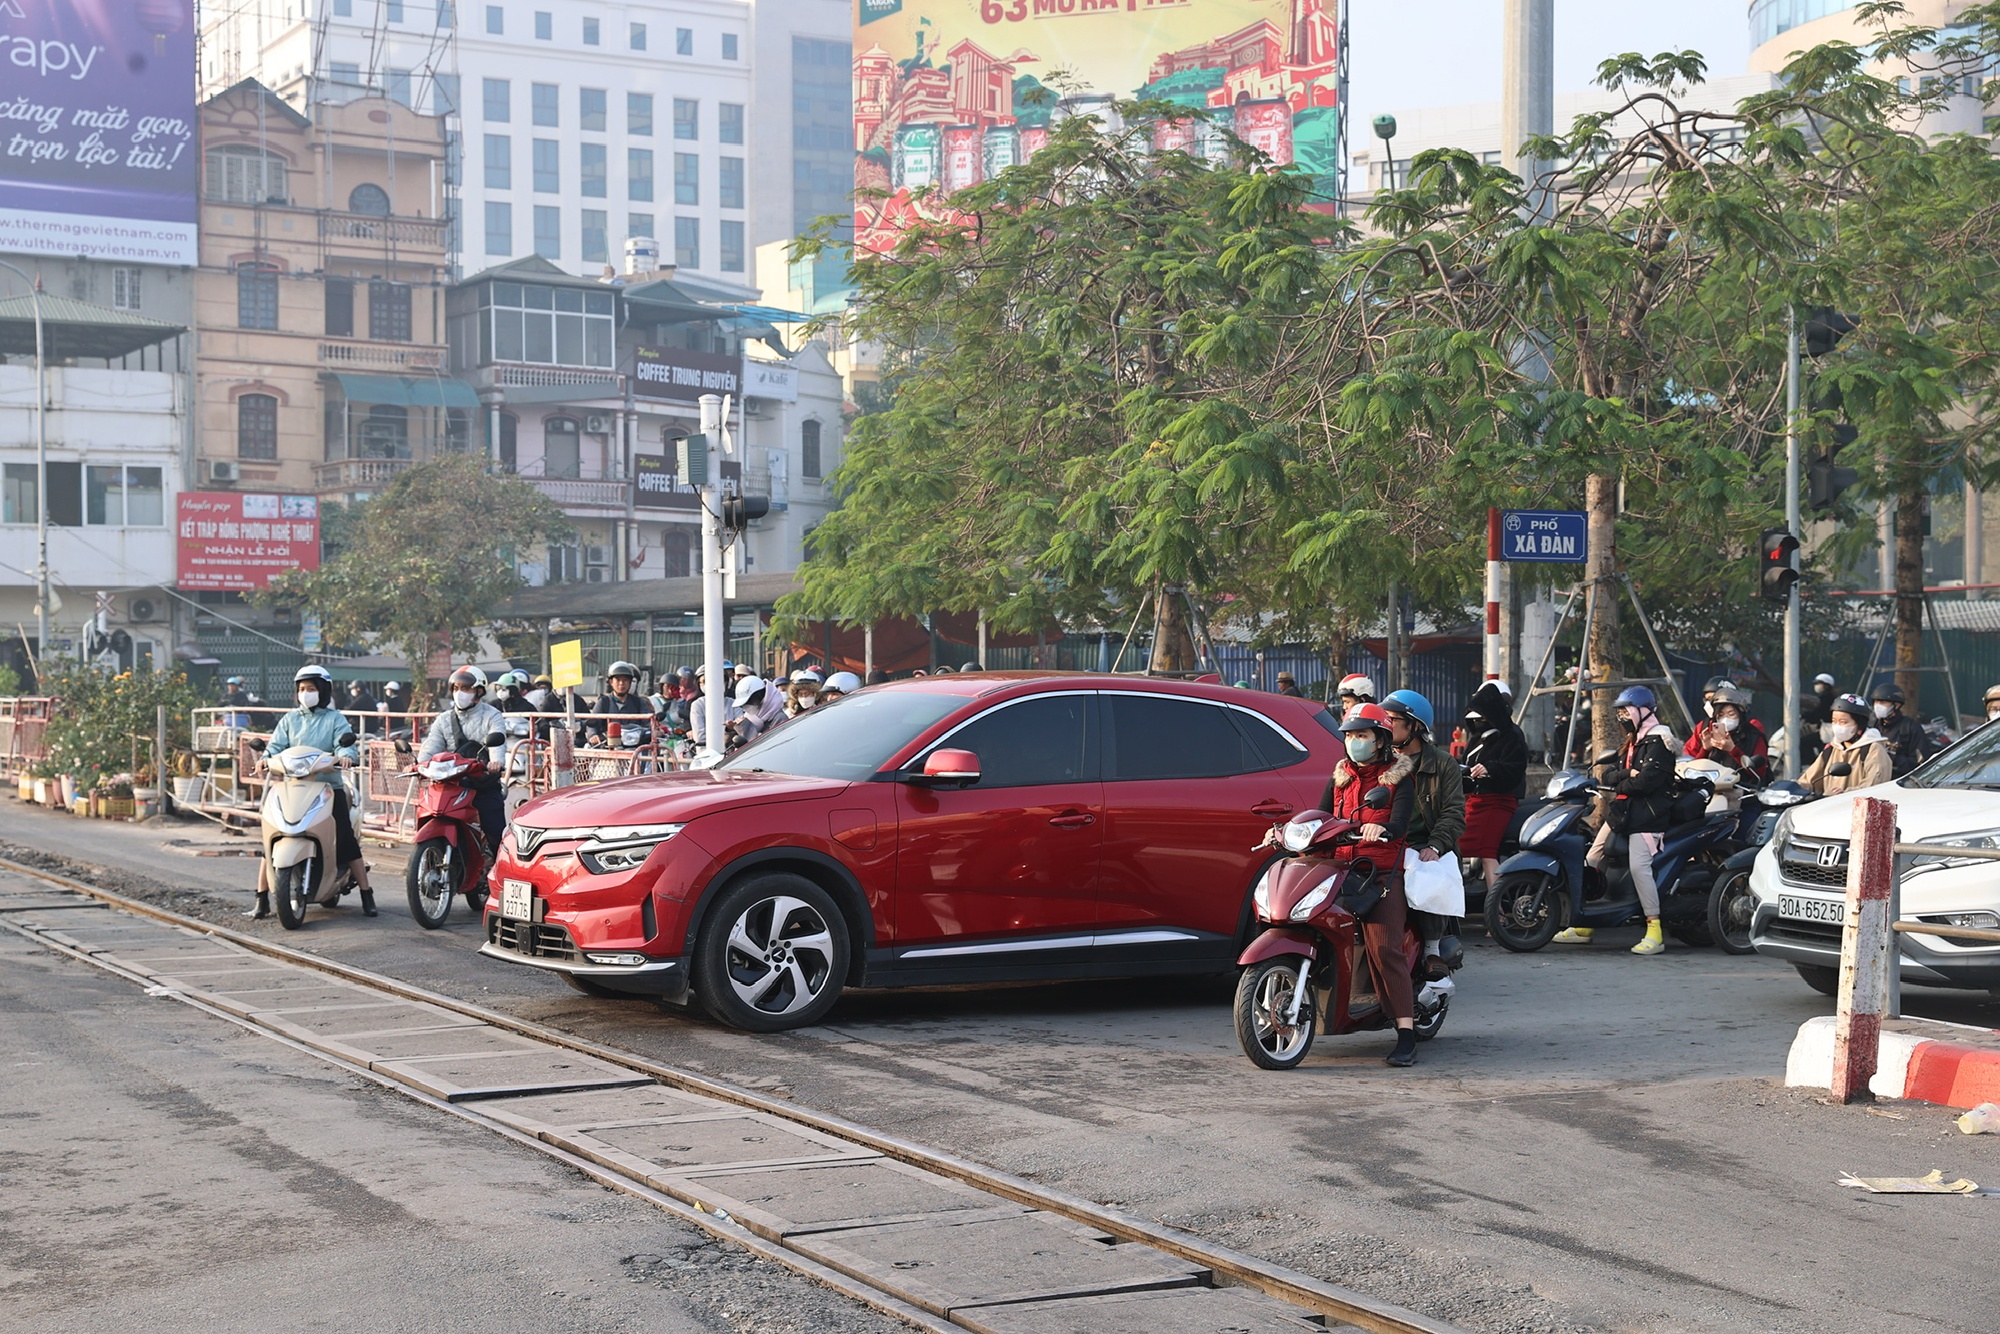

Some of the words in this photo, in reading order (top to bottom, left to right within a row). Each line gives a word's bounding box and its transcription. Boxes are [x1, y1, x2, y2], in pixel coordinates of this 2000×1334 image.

[72, 104, 129, 133] mặt
[131, 115, 191, 142] gọn,
[7, 133, 69, 164] trọn
[75, 132, 119, 169] lộc
[126, 142, 185, 170] tài!
[637, 361, 670, 383] COFFEE
[672, 366, 701, 387] TRUNG
[702, 370, 737, 391] NGUYÊN
[638, 473, 670, 493] COFFEE
[1530, 517, 1558, 530] PHỐ
[205, 544, 245, 557] NHẬN
[1514, 532, 1537, 553] XÃ
[1541, 532, 1575, 554] ĐÀN
[511, 883, 523, 899] 30K
[506, 900, 528, 918] 237.76
[1780, 898, 1844, 922] 30A-652.50
